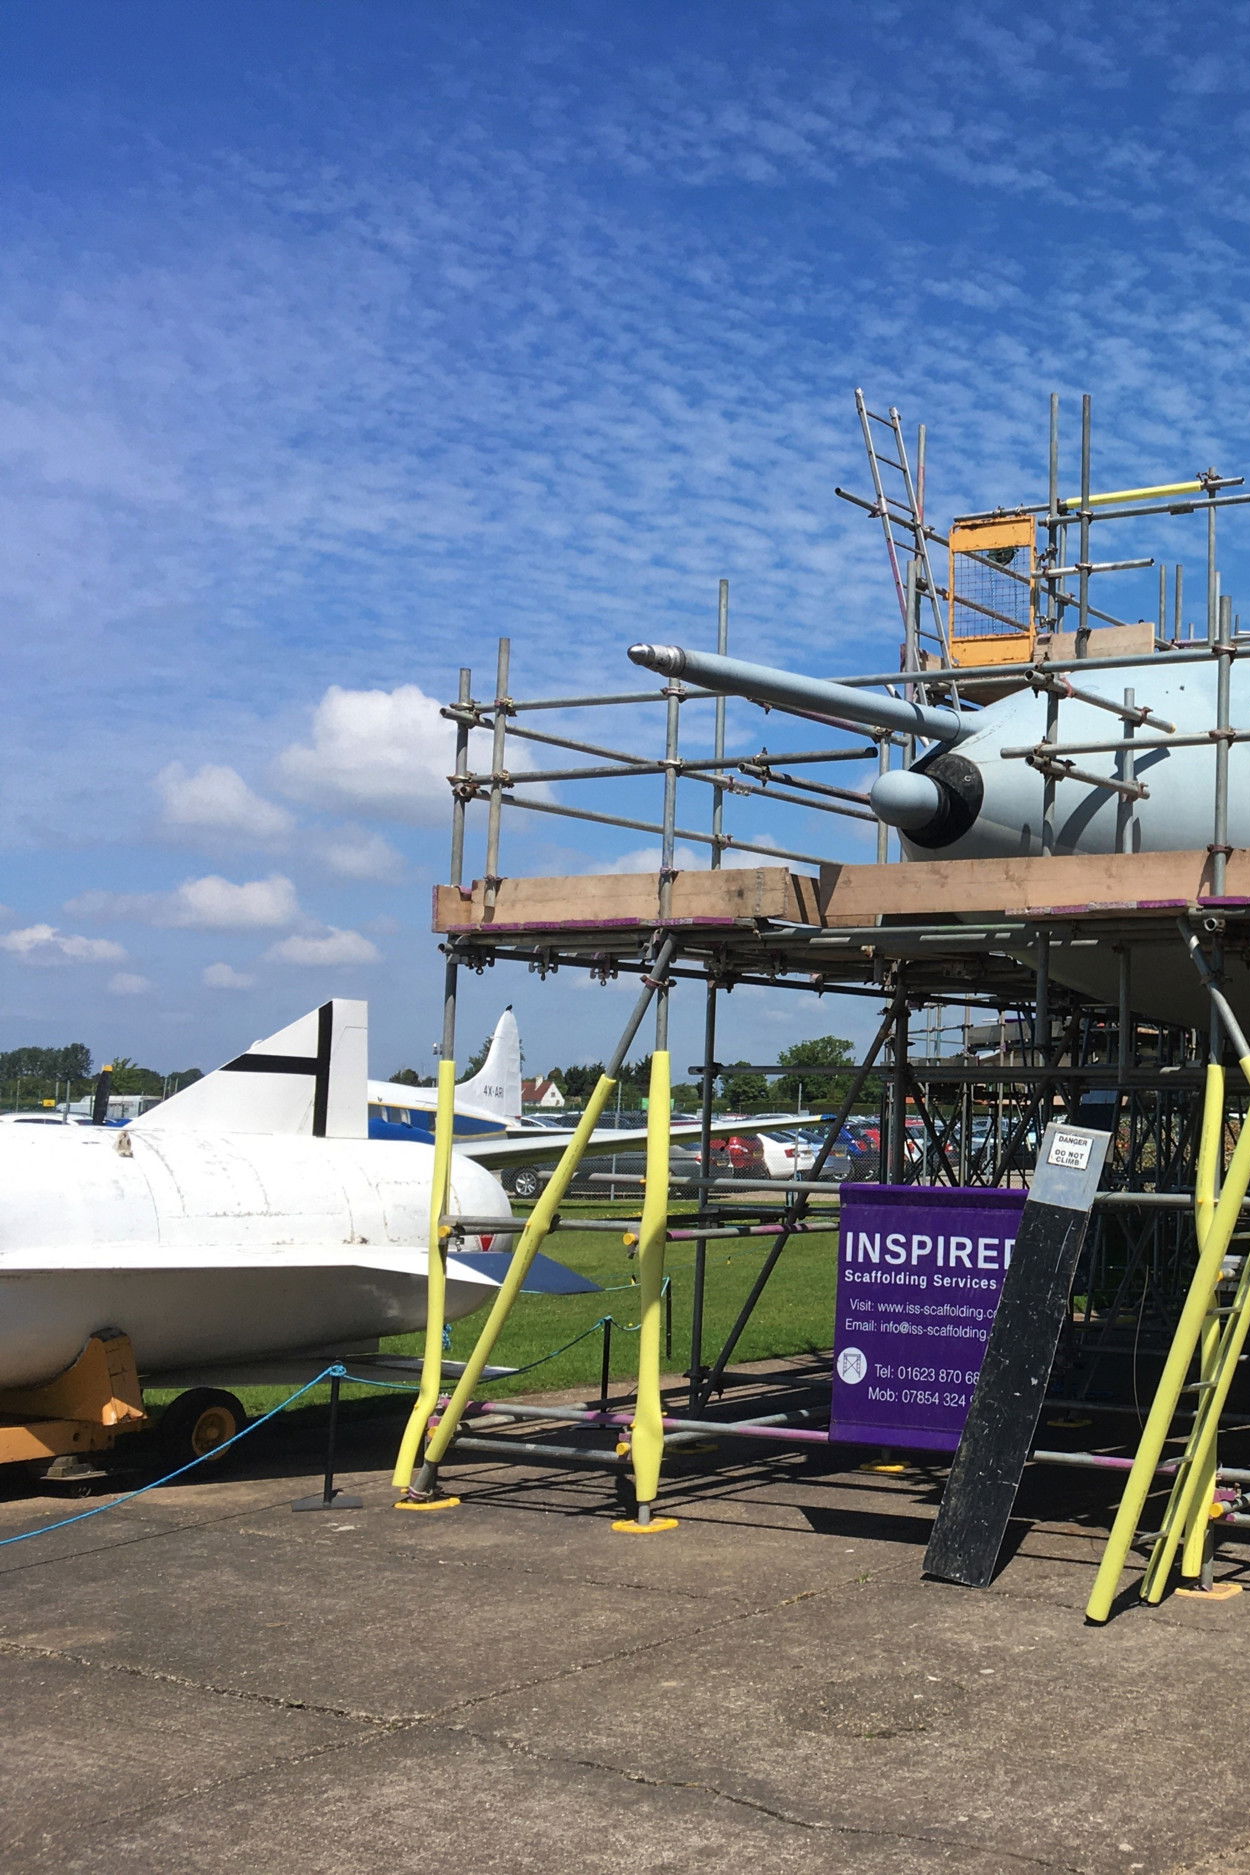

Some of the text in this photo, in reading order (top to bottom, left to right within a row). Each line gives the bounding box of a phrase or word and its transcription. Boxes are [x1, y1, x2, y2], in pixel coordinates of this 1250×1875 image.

[1058, 1136, 1088, 1146] DANGER
[1055, 1149, 1085, 1160] DO NOT
[1055, 1156, 1080, 1165] CLIMB
[844, 1269, 997, 1289] Scaffolding Services
[850, 1299, 874, 1312] Visit:
[845, 1318, 877, 1332] Email:
[874, 1364, 894, 1378] Tel:
[897, 1366, 935, 1381] 01623
[938, 1368, 962, 1384] 870
[868, 1386, 898, 1401] Mob:
[902, 1390, 939, 1405] 07854
[943, 1392, 966, 1407] 324
